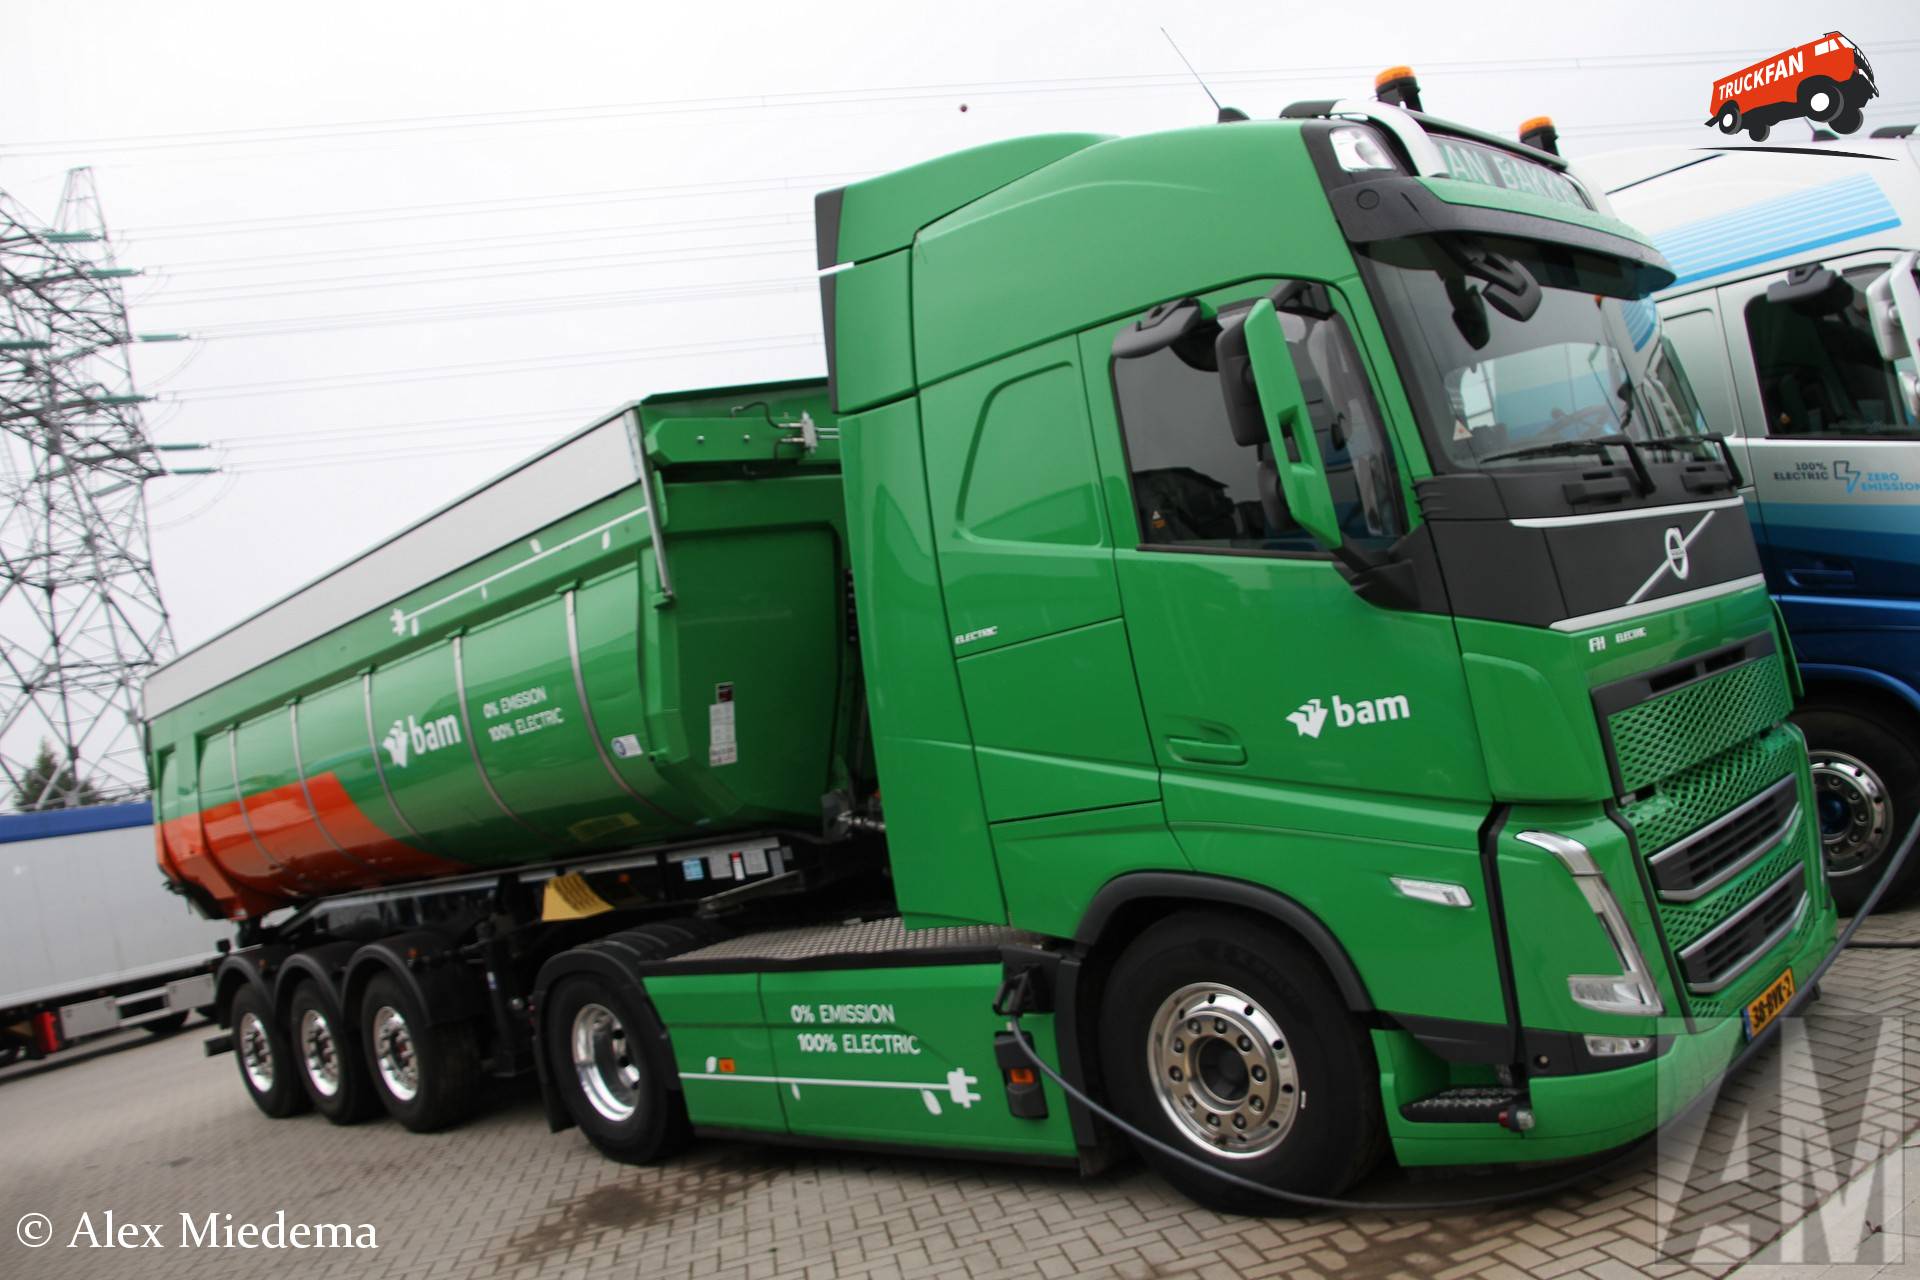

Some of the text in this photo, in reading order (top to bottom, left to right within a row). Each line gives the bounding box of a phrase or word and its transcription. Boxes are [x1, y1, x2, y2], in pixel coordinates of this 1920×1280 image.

[1774, 472, 1830, 481] ELECTRIC
[1796, 462, 1828, 471] 100%
[1867, 472, 1900, 481] ZERO
[1588, 636, 1606, 653] FH
[483, 686, 548, 719] 0% EMISSION
[1332, 694, 1411, 728] bam
[407, 714, 462, 755] bam
[488, 707, 565, 742] 100% ELECTRIC
[790, 1003, 896, 1024] 0% EMISSION
[796, 1033, 921, 1055] 100% ELECTRIC
